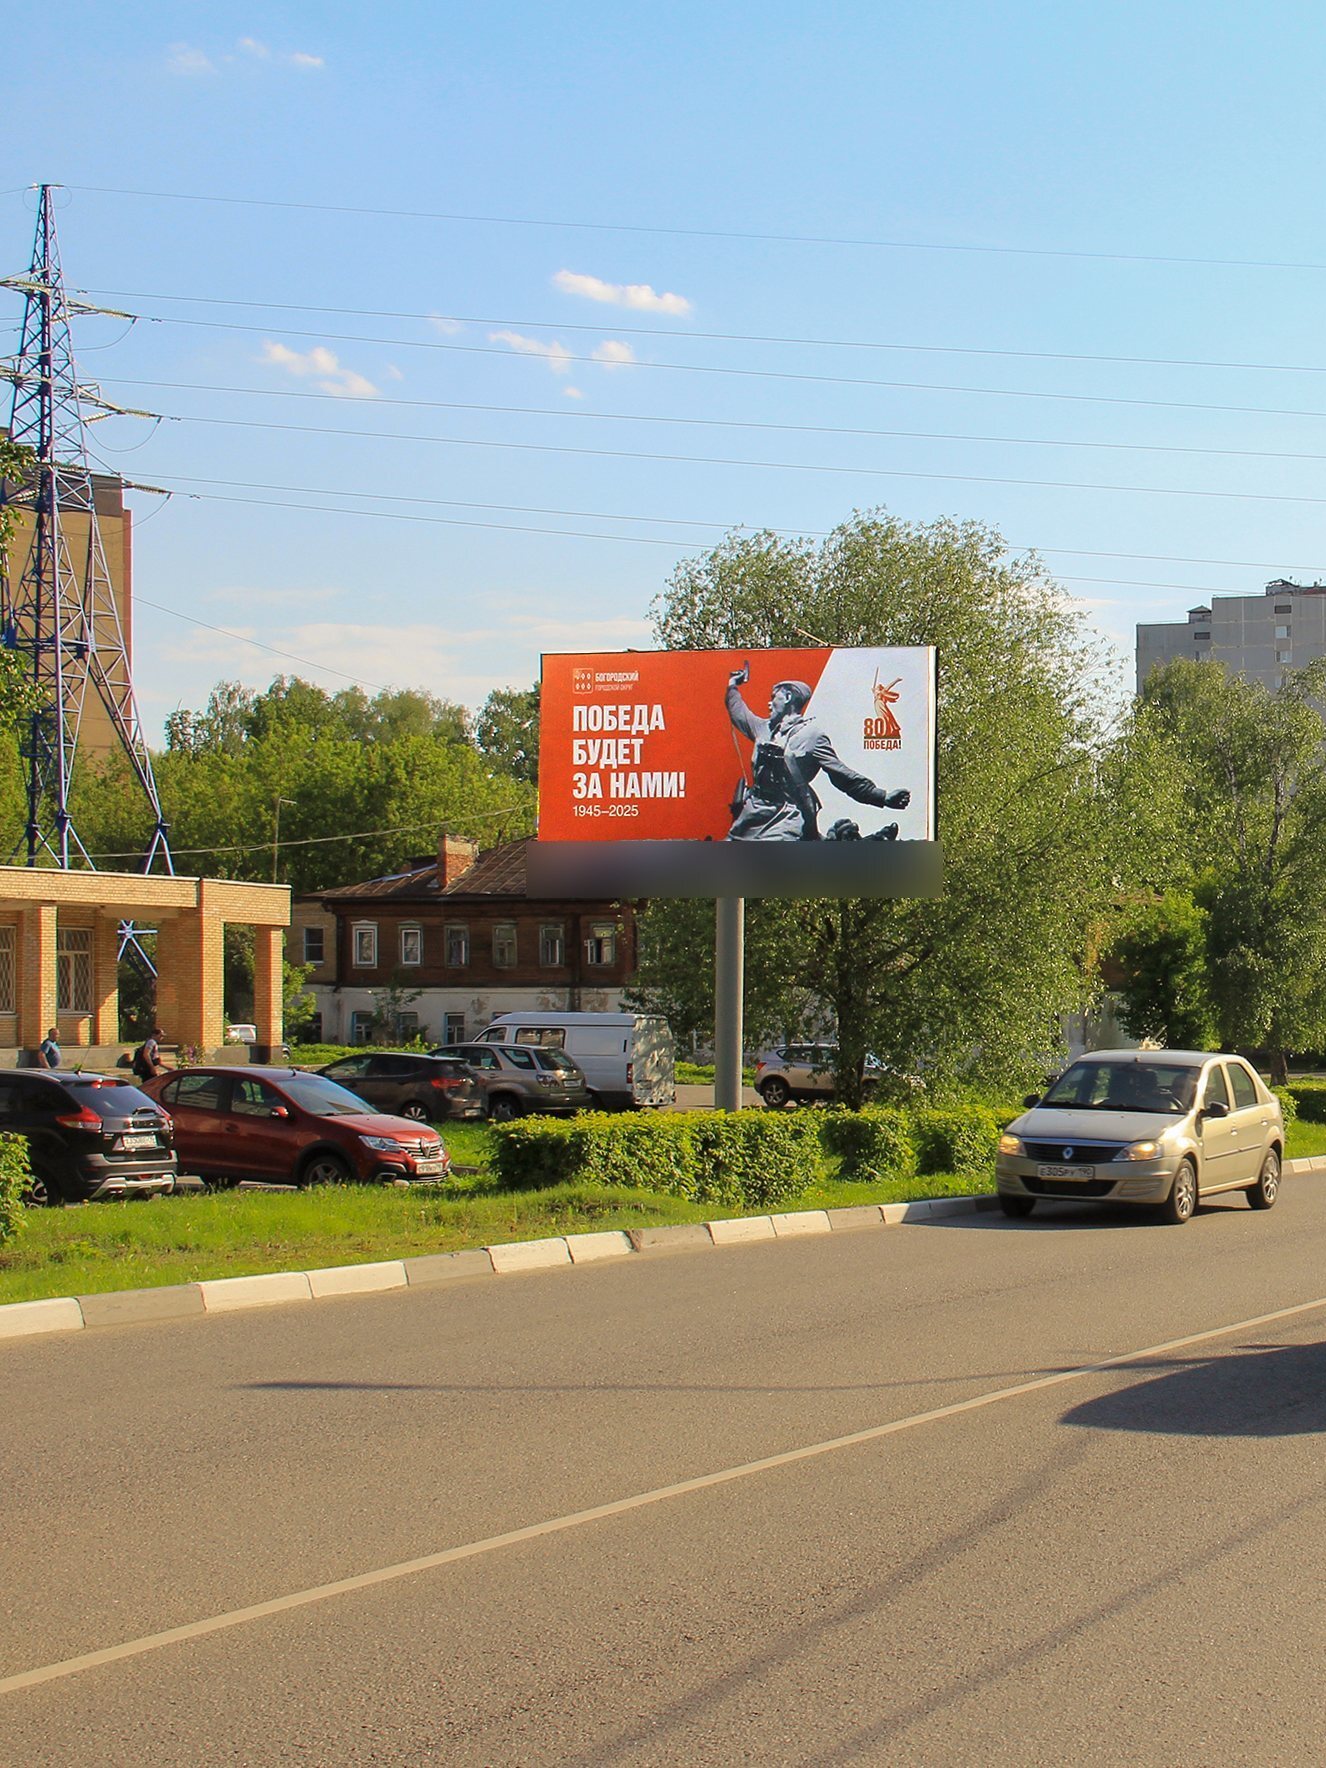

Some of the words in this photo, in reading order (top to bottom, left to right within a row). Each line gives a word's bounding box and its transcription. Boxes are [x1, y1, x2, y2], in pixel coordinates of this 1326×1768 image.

[595, 670, 639, 682] БОГОРОДСКИЙ
[573, 704, 665, 735] ПОБЕДА
[864, 718, 885, 736] 80
[572, 739, 644, 769] БУДЕТ
[864, 740, 901, 750] ПОБЕДА!
[572, 772, 603, 799] ЗА
[610, 771, 685, 798] НАМИ!
